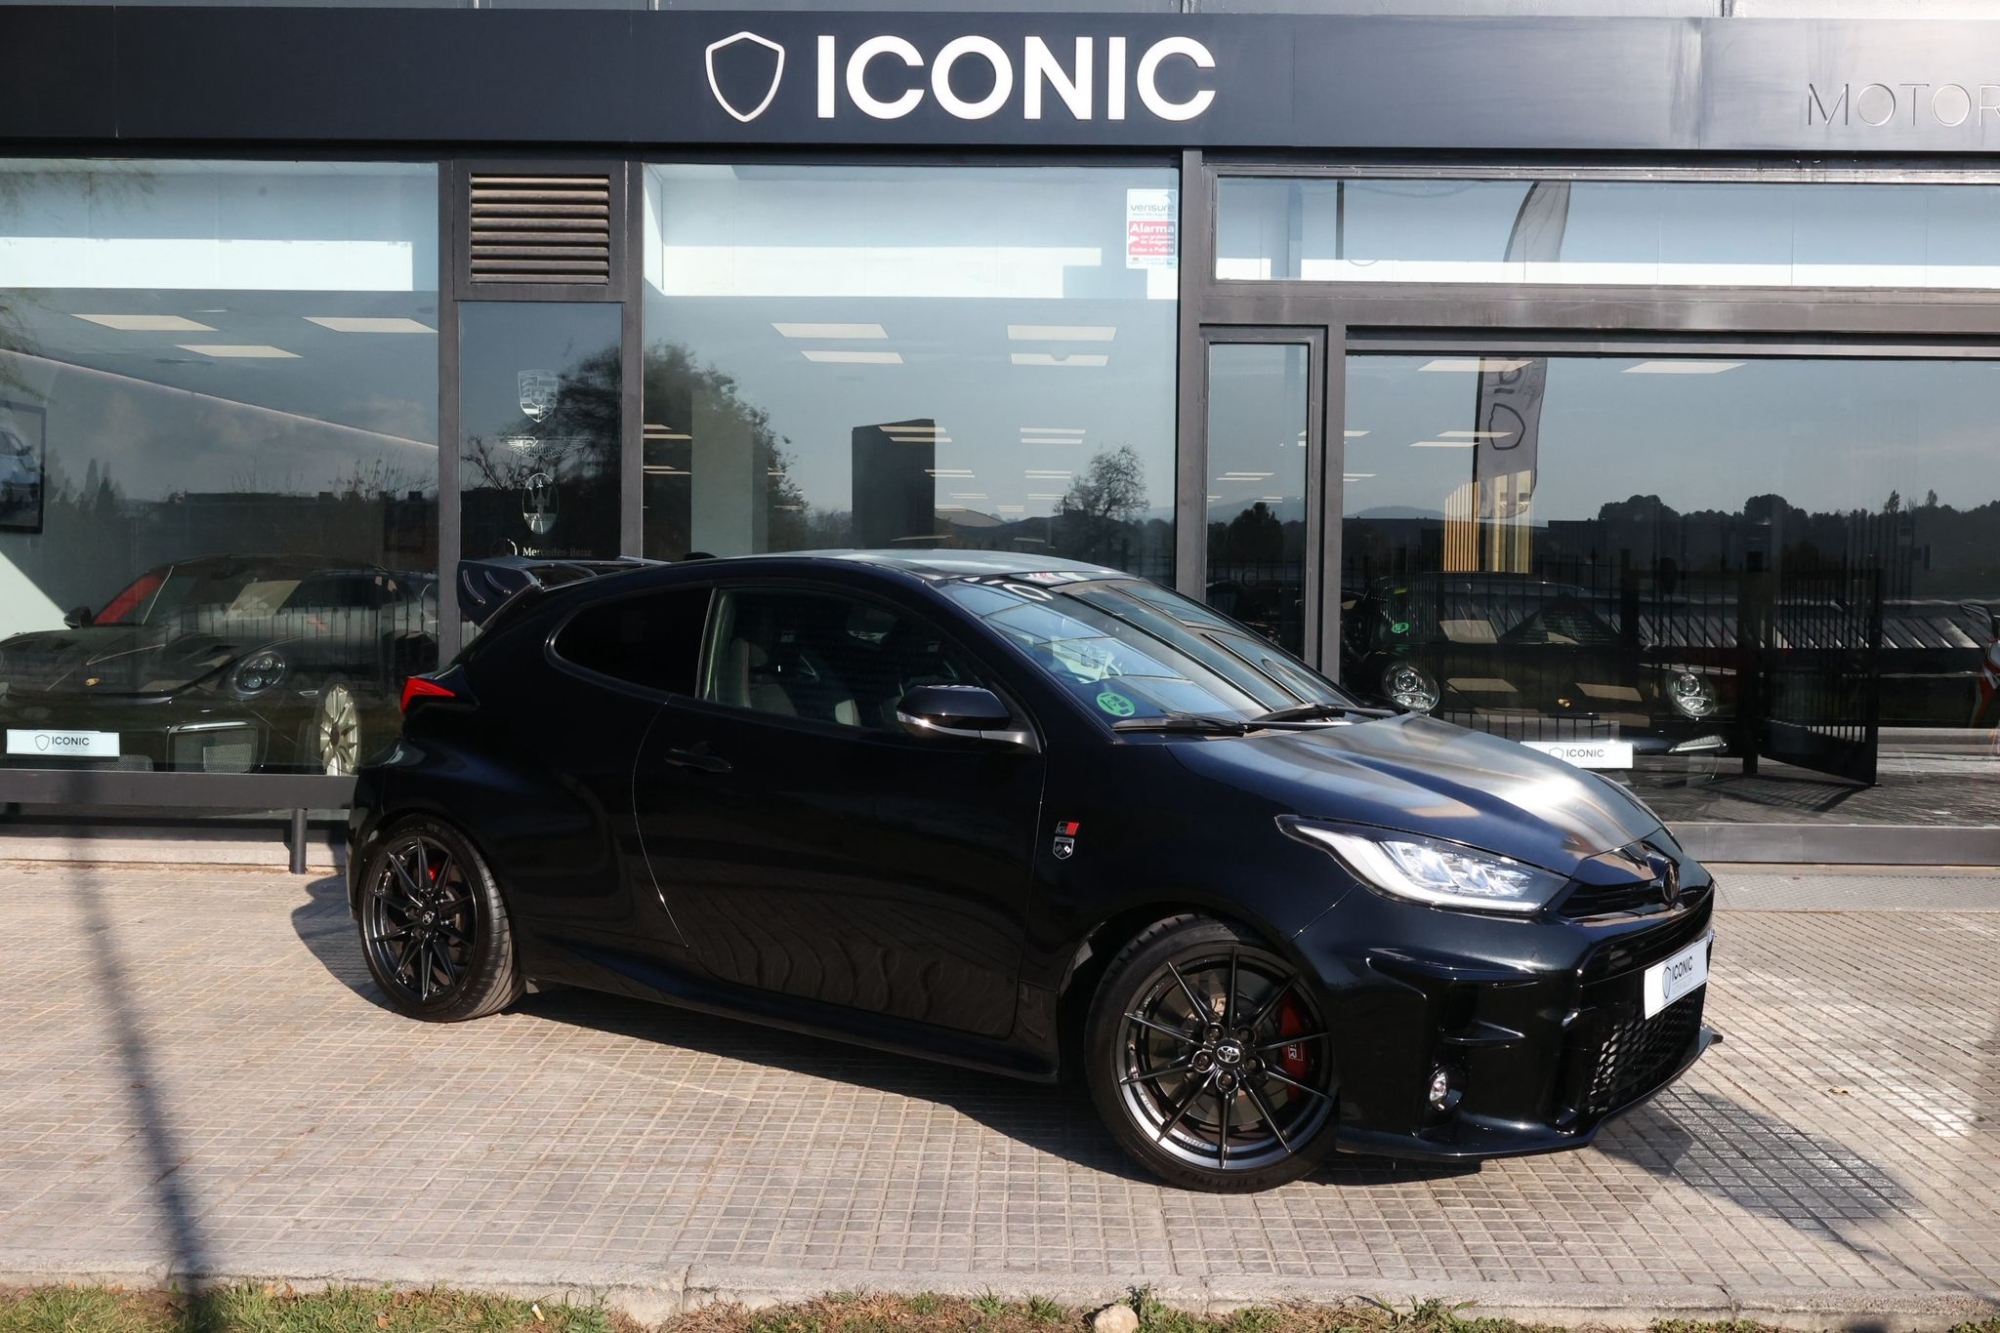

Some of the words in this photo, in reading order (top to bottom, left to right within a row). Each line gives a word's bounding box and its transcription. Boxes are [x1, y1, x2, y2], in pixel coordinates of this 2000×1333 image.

[817, 35, 1216, 121] ICONIC
[1808, 83, 2000, 127] MOTOR
[1130, 203, 1174, 212] verisure
[1130, 222, 1175, 233] Alarma
[51, 736, 90, 747] ICONIC
[1566, 748, 1605, 758] ICONIC
[1671, 955, 1693, 982] ICONIC
